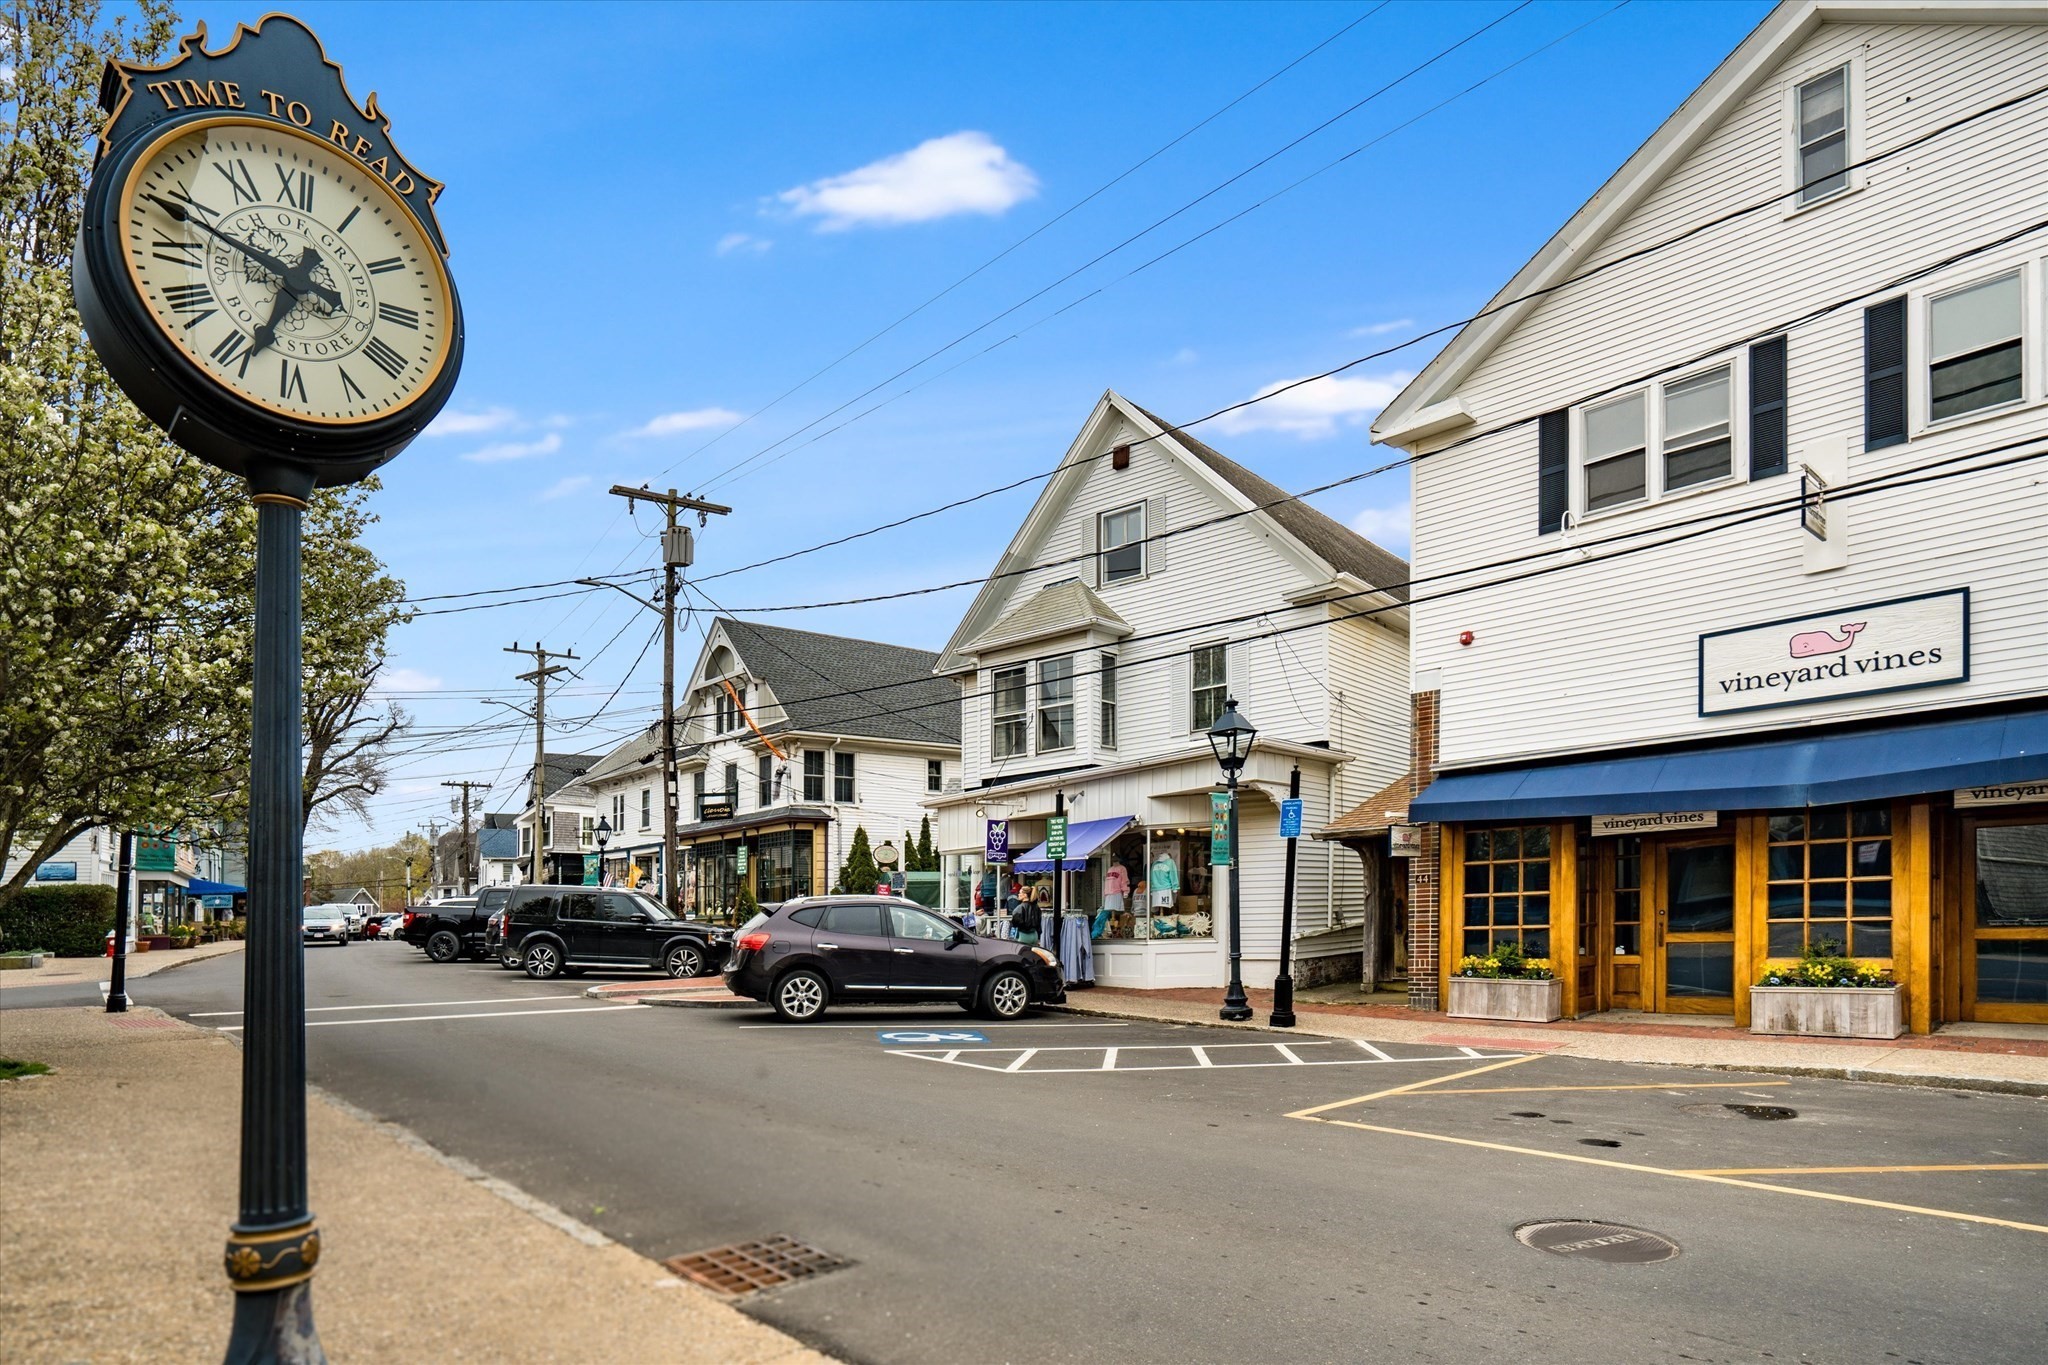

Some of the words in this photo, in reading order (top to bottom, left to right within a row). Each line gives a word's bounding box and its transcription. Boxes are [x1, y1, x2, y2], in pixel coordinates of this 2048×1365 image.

[147, 79, 246, 110] TIME
[261, 89, 312, 127] TO
[329, 119, 415, 195] READ
[275, 162, 315, 213] XII
[278, 213, 306, 230] OF
[321, 233, 370, 309] GRAPES
[226, 296, 354, 355] BOKSTORE
[1718, 655, 1849, 693] vineyard
[1854, 647, 1942, 674] vines
[1603, 813, 1663, 830] vineyard
[1665, 812, 1704, 824] vines
[1416, 875, 1429, 884] 44
